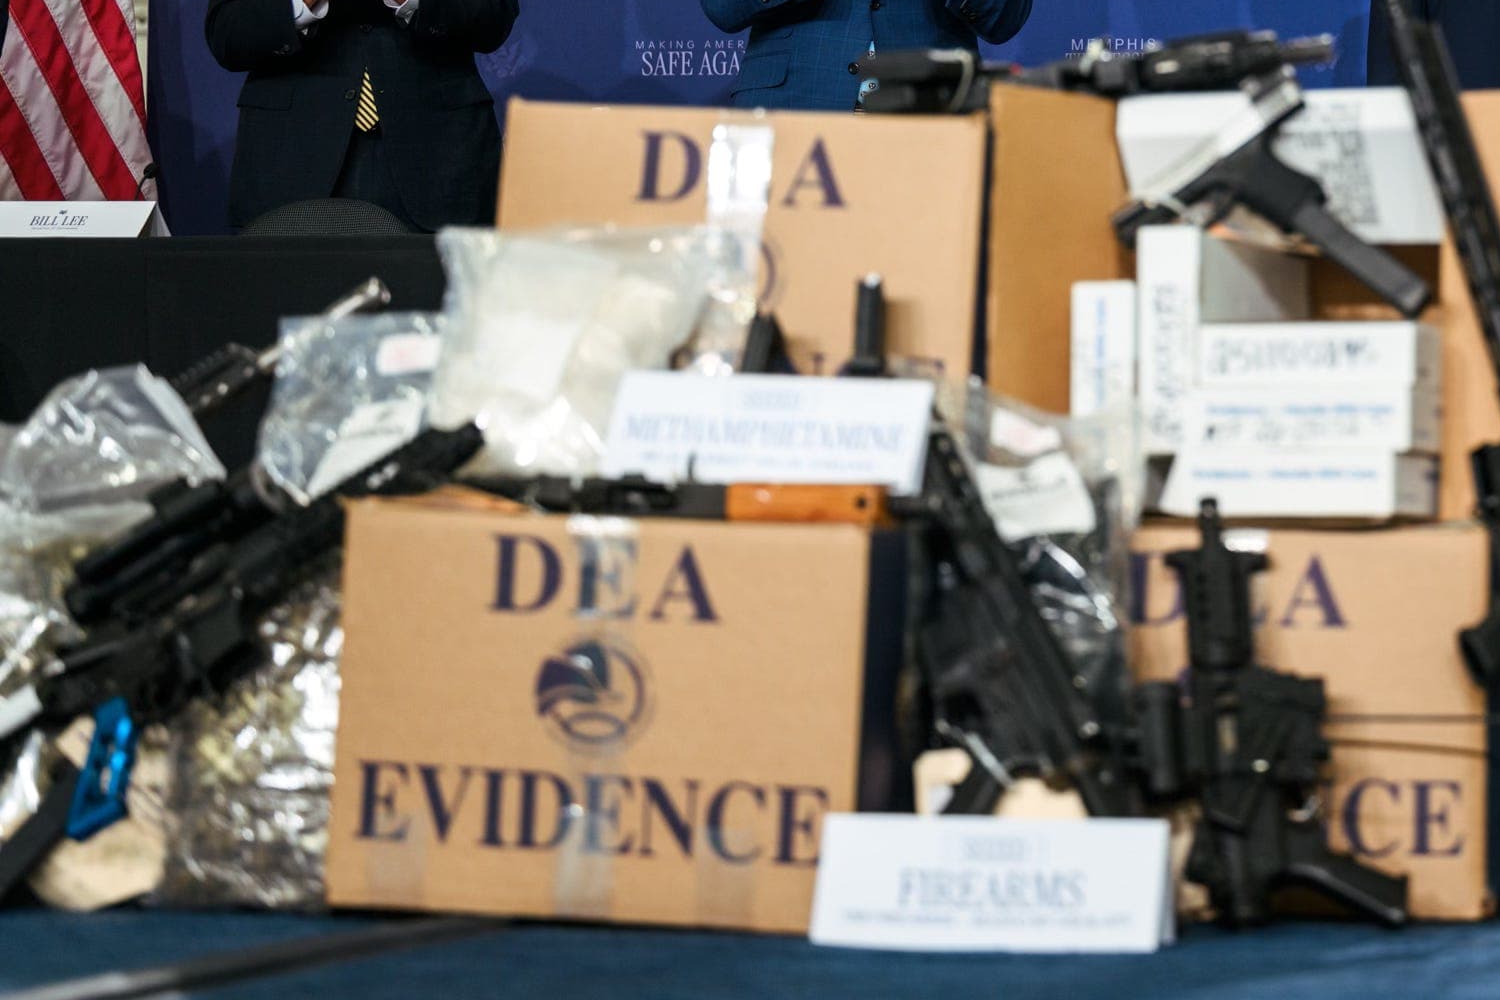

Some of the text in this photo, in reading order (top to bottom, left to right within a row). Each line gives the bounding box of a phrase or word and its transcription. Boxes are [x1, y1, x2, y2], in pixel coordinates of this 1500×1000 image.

[635, 39, 745, 49] MAKING AMER
[641, 50, 741, 76] SAFE AGA
[634, 129, 847, 207] DA
[29, 215, 88, 226] BILL LEE
[488, 534, 719, 623] DEA
[355, 759, 831, 865] EVIDENCE
